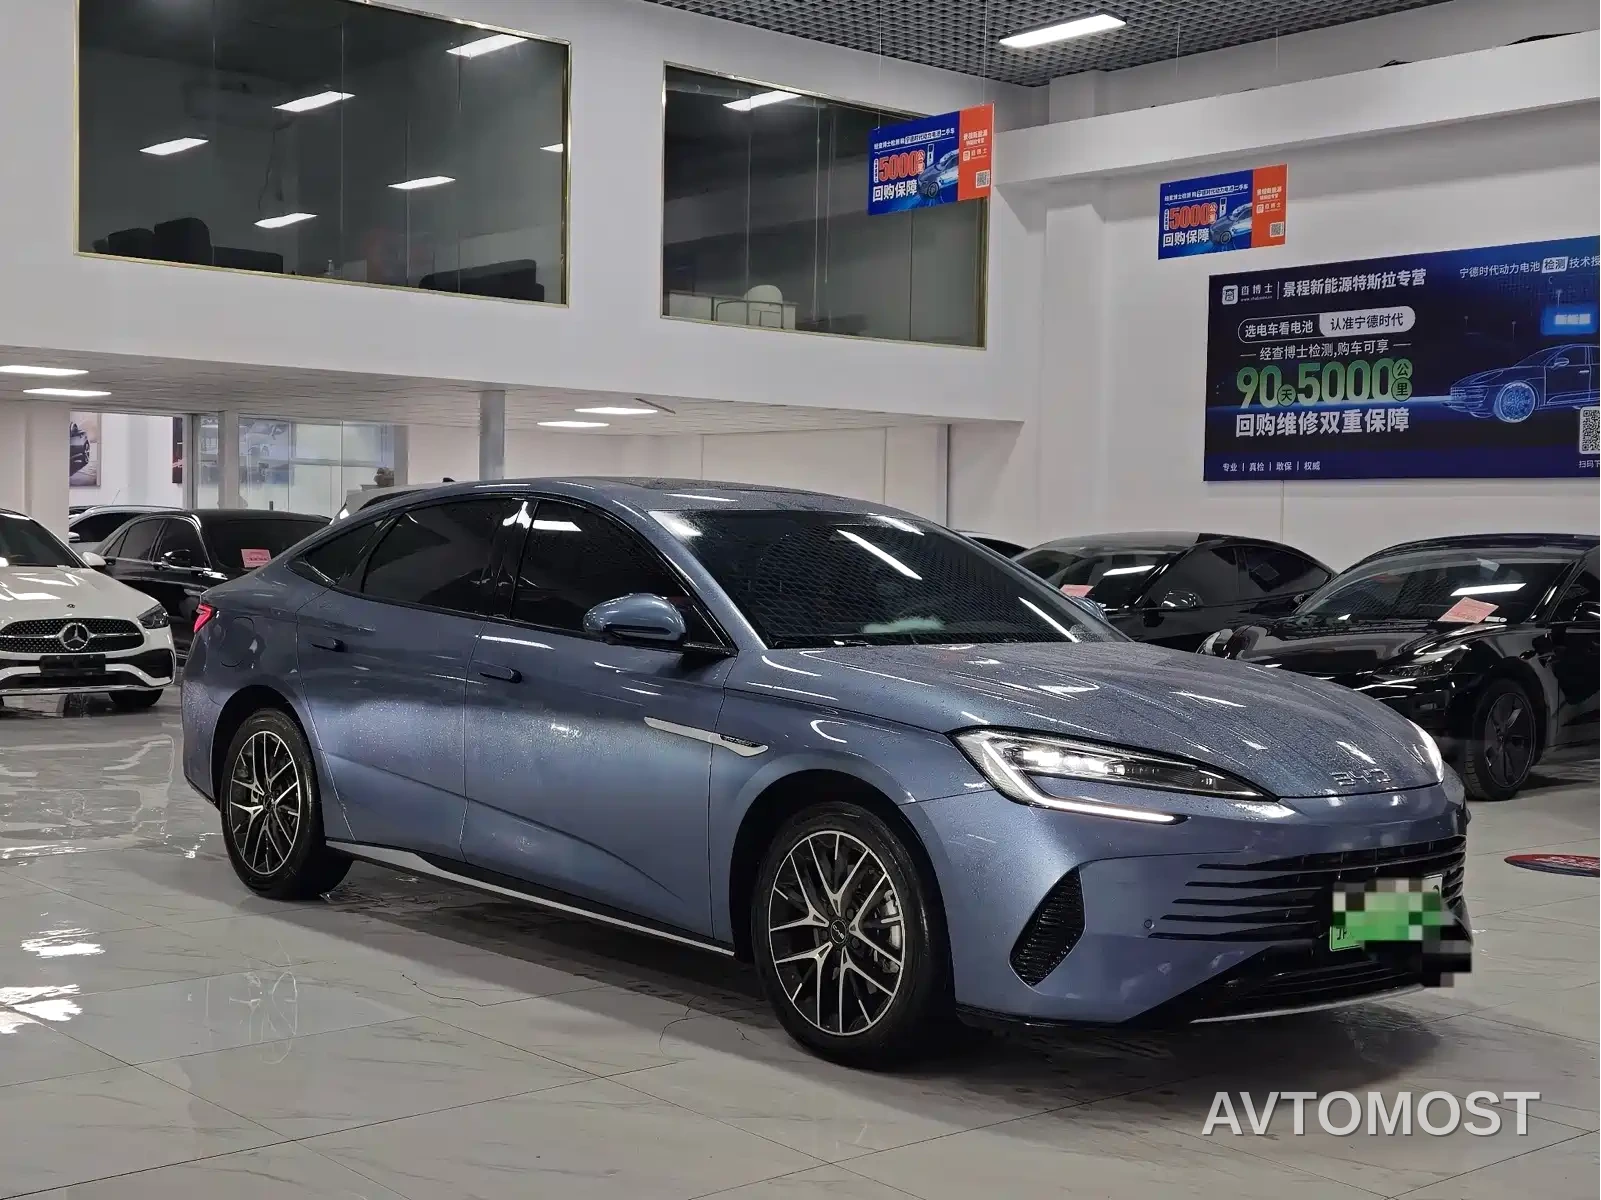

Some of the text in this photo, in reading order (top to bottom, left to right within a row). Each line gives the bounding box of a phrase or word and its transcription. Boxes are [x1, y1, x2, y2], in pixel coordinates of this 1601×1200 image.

[873, 179, 917, 203] 回购保障
[1163, 228, 1210, 248] 回购保障
[1283, 268, 1427, 298] 景程新能源特斯拉专营
[1245, 312, 1404, 338] 选电车看电池 认准宁德时代
[1236, 407, 1410, 438] 回购维修双重保障
